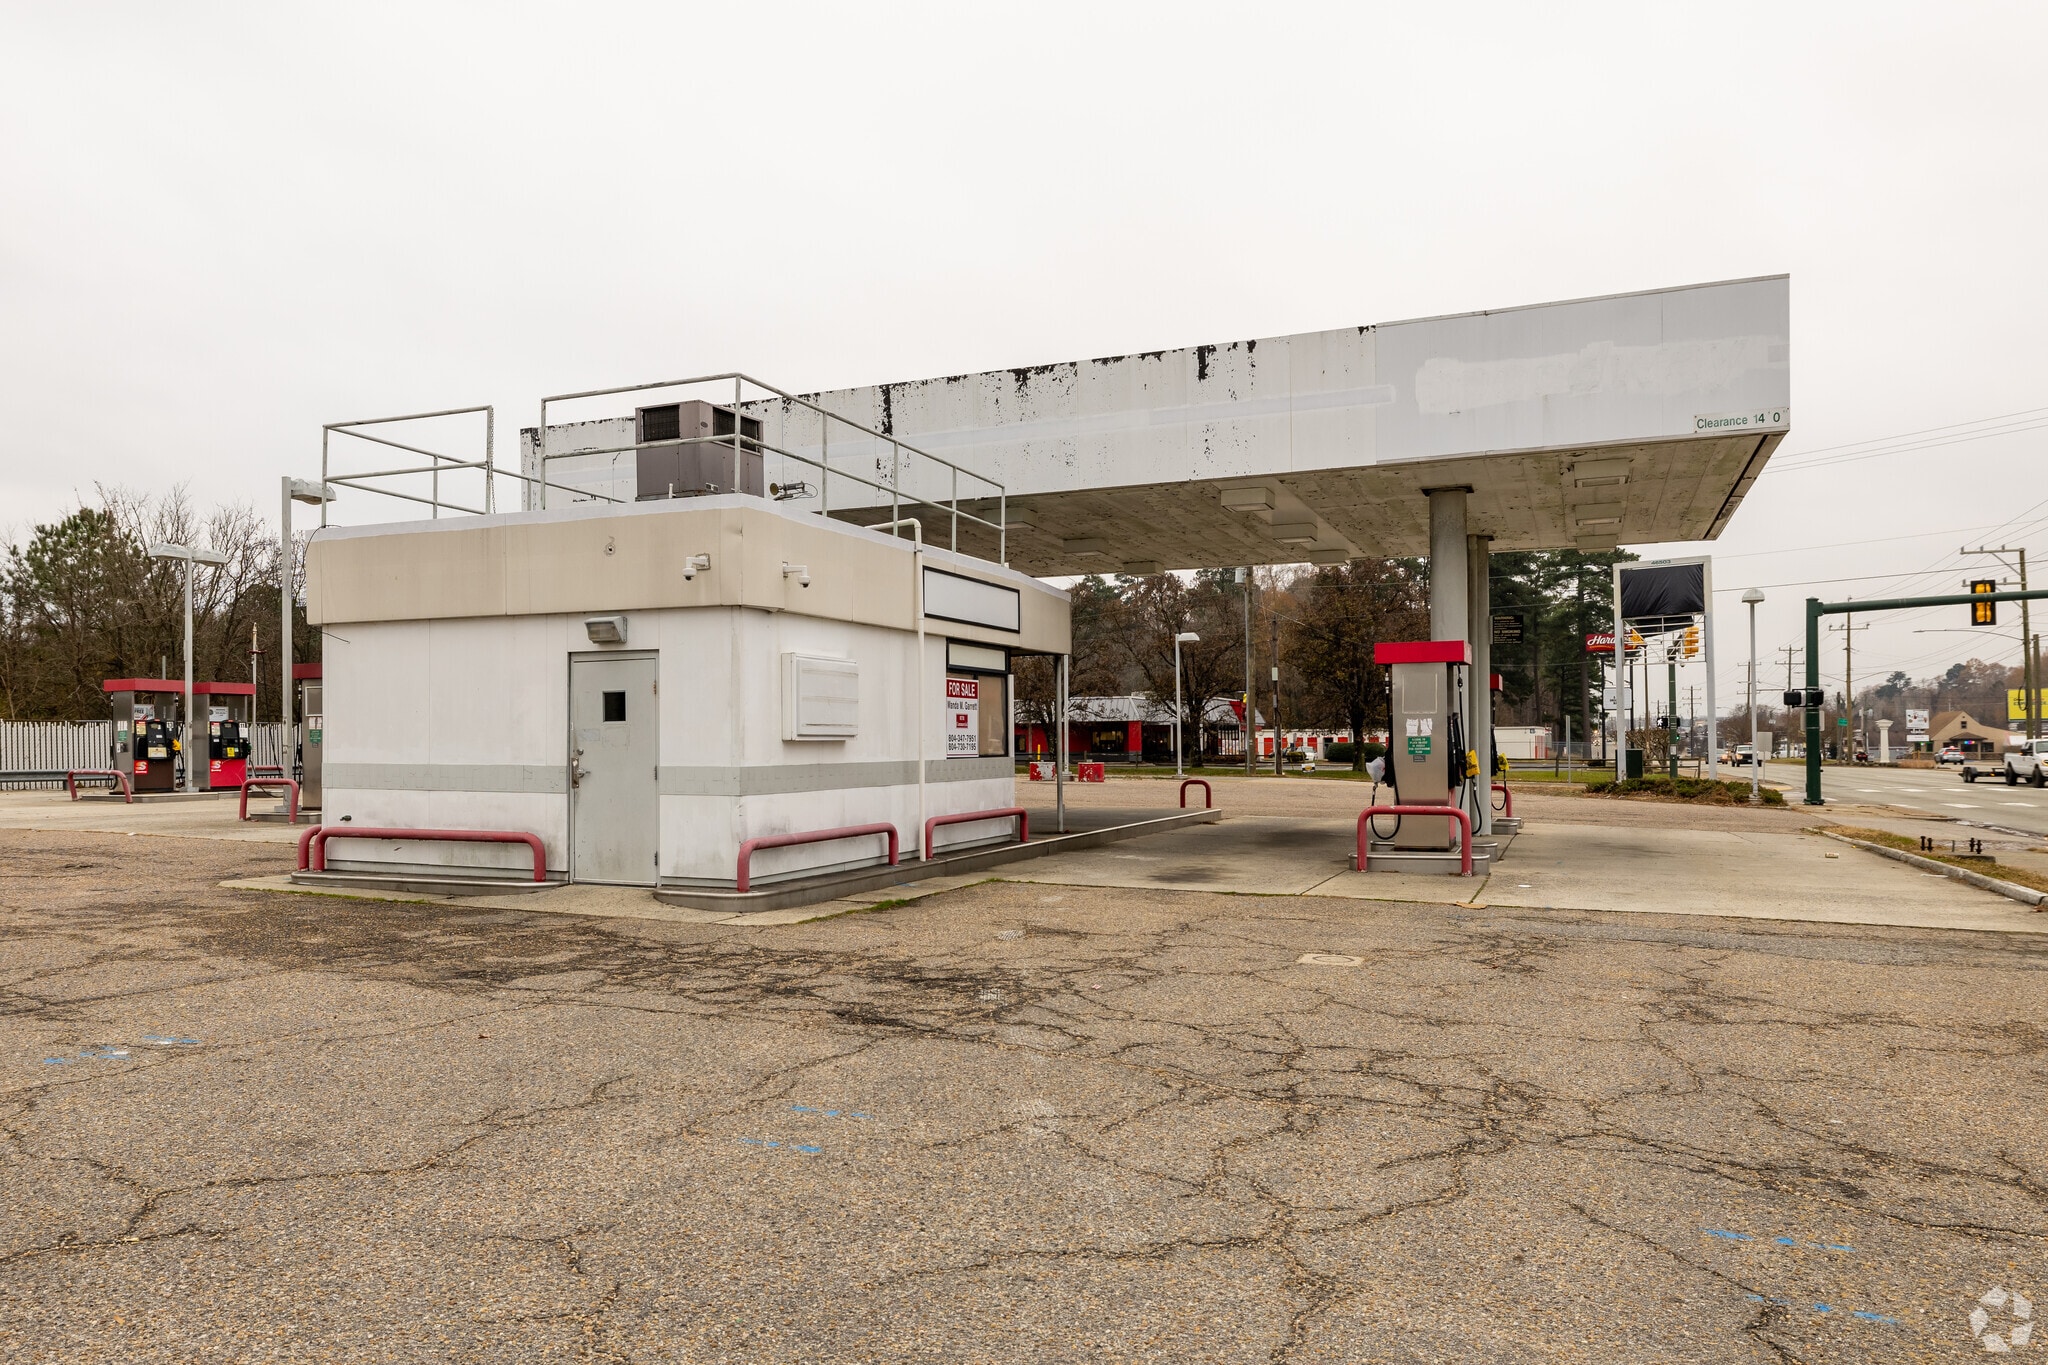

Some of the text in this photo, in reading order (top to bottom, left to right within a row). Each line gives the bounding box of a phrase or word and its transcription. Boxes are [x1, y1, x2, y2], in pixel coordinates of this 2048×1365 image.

[1697, 416, 1748, 429] Clearance
[948, 682, 976, 697] FOR SALE
[947, 701, 959, 709] Wanda
